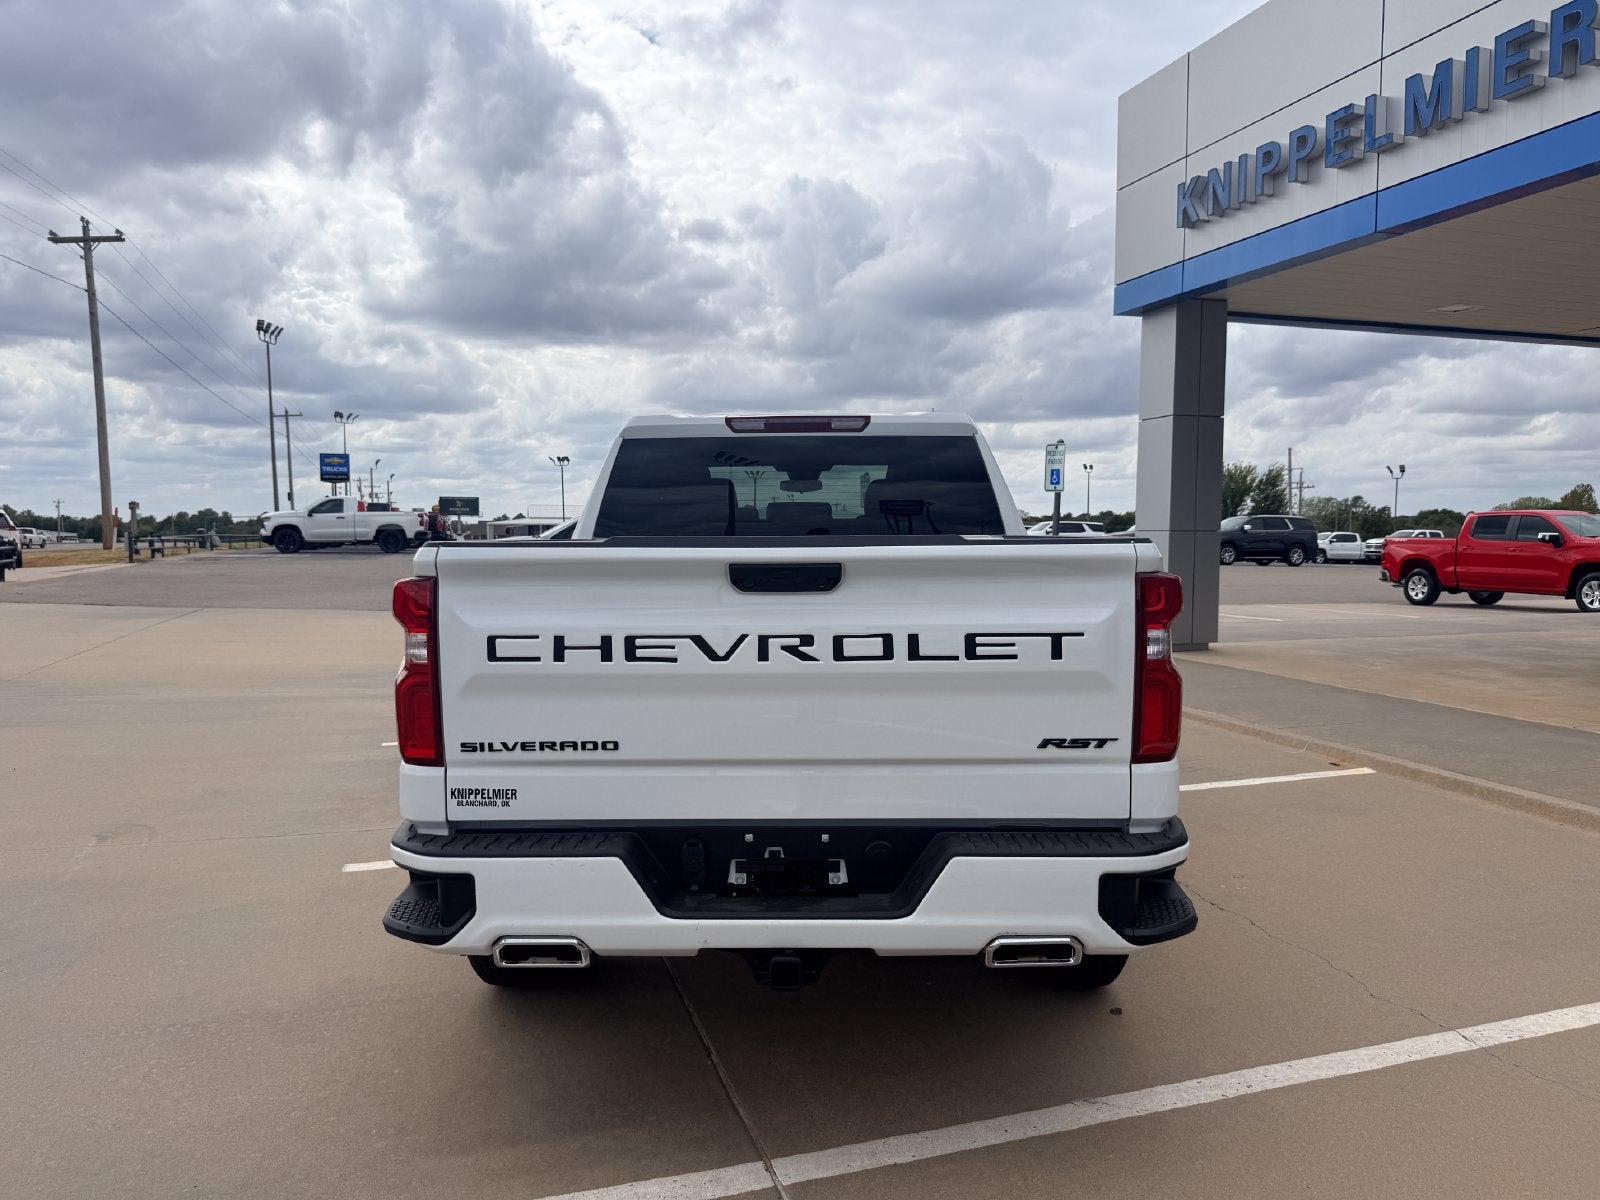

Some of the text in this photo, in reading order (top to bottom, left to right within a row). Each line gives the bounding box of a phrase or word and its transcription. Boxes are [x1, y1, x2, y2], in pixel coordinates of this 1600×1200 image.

[1176, 0, 1600, 229] KNIPPELMIER
[486, 632, 1085, 664] CHEVROLET
[460, 740, 620, 753] SILVERADO
[1036, 737, 1119, 749] RST
[450, 787, 518, 800] KNIPPELMIER
[456, 800, 511, 808] BLANCHARD, OK
